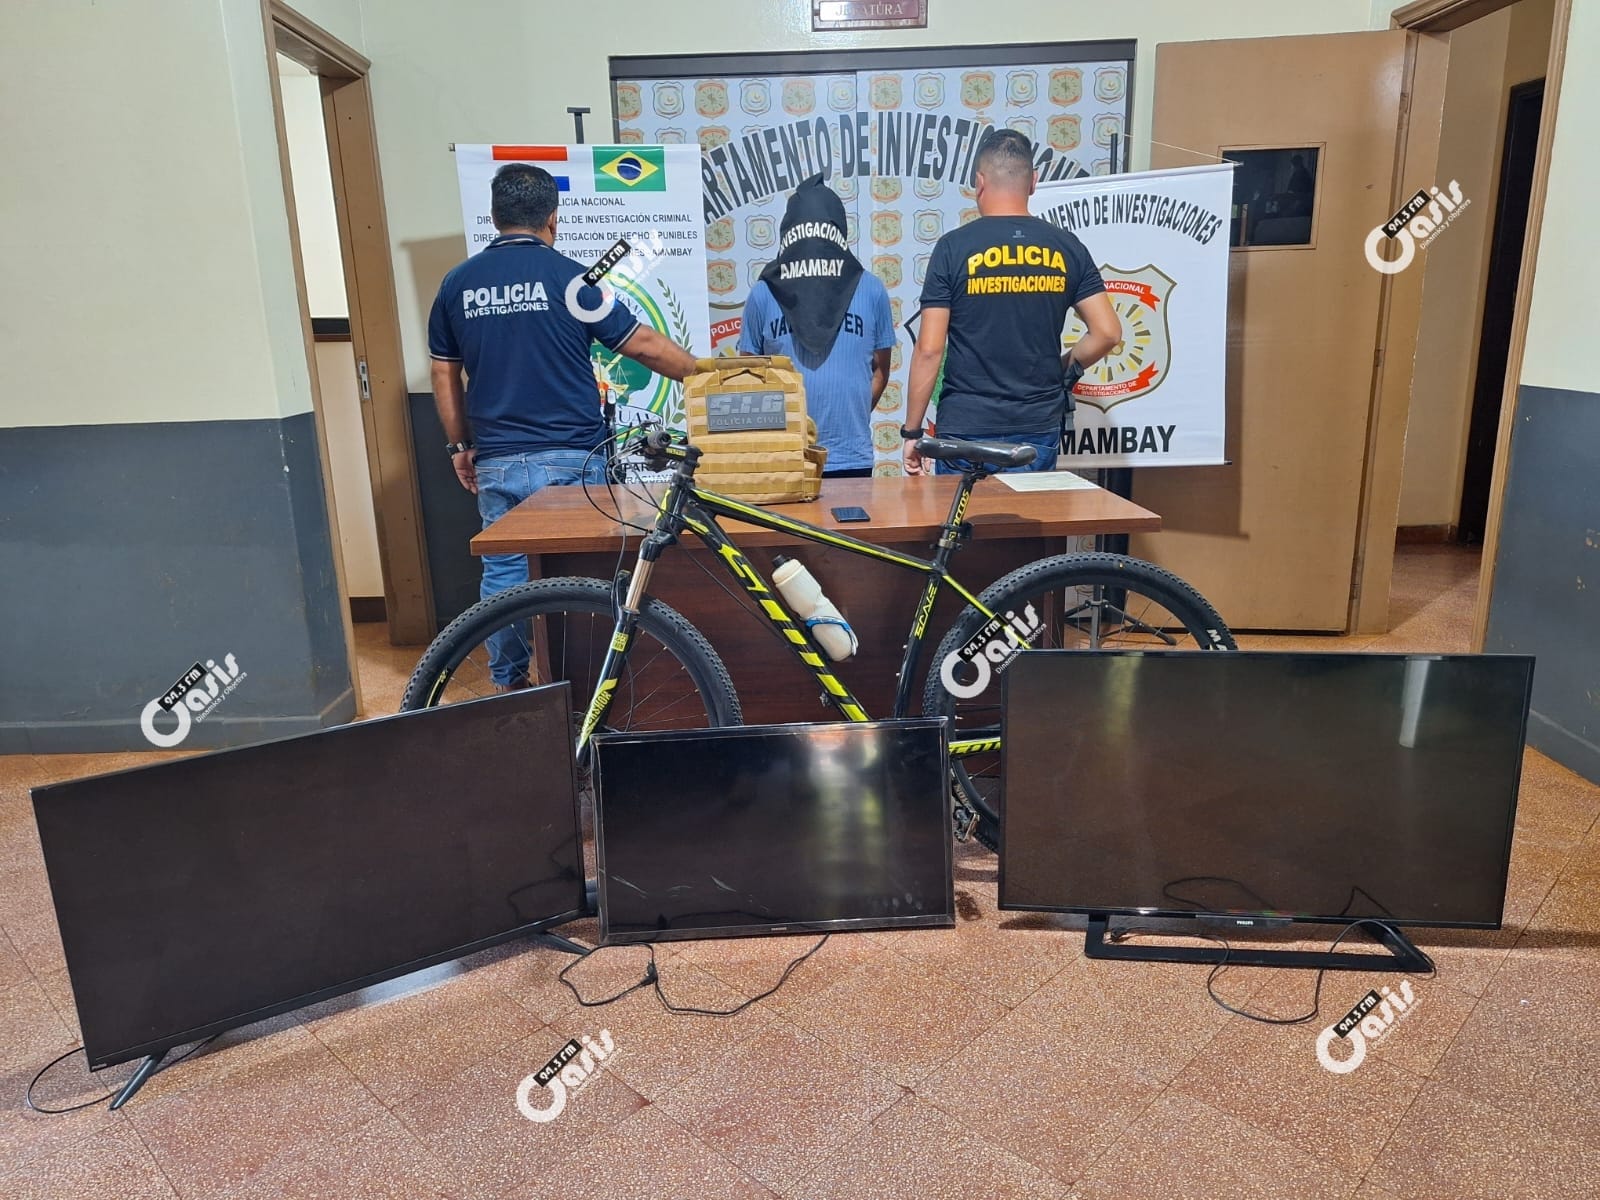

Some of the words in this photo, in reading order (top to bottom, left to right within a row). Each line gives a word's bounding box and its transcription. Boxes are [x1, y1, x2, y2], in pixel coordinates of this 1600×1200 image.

[840, 112, 870, 178] DE
[558, 197, 580, 206] LICIA
[581, 198, 625, 206] NACIONAL
[572, 215, 583, 223] DE
[652, 214, 692, 223] CRIMINAL
[1094, 195, 1108, 225] DE
[1112, 193, 1223, 245] INVESTIGACIONES
[607, 232, 619, 240] DE
[658, 230, 697, 239] PUNIBLES
[780, 259, 844, 280] AMAMBAY
[967, 245, 1067, 275] POLICIA
[967, 275, 1066, 294] INVESTIGACIONES
[463, 282, 548, 309] POLICIA
[464, 302, 549, 319] INVESTIGACIONES
[711, 320, 741, 337] POLIC
[756, 415, 785, 424] CIVIL
[1058, 425, 1177, 455] MAMBAY
